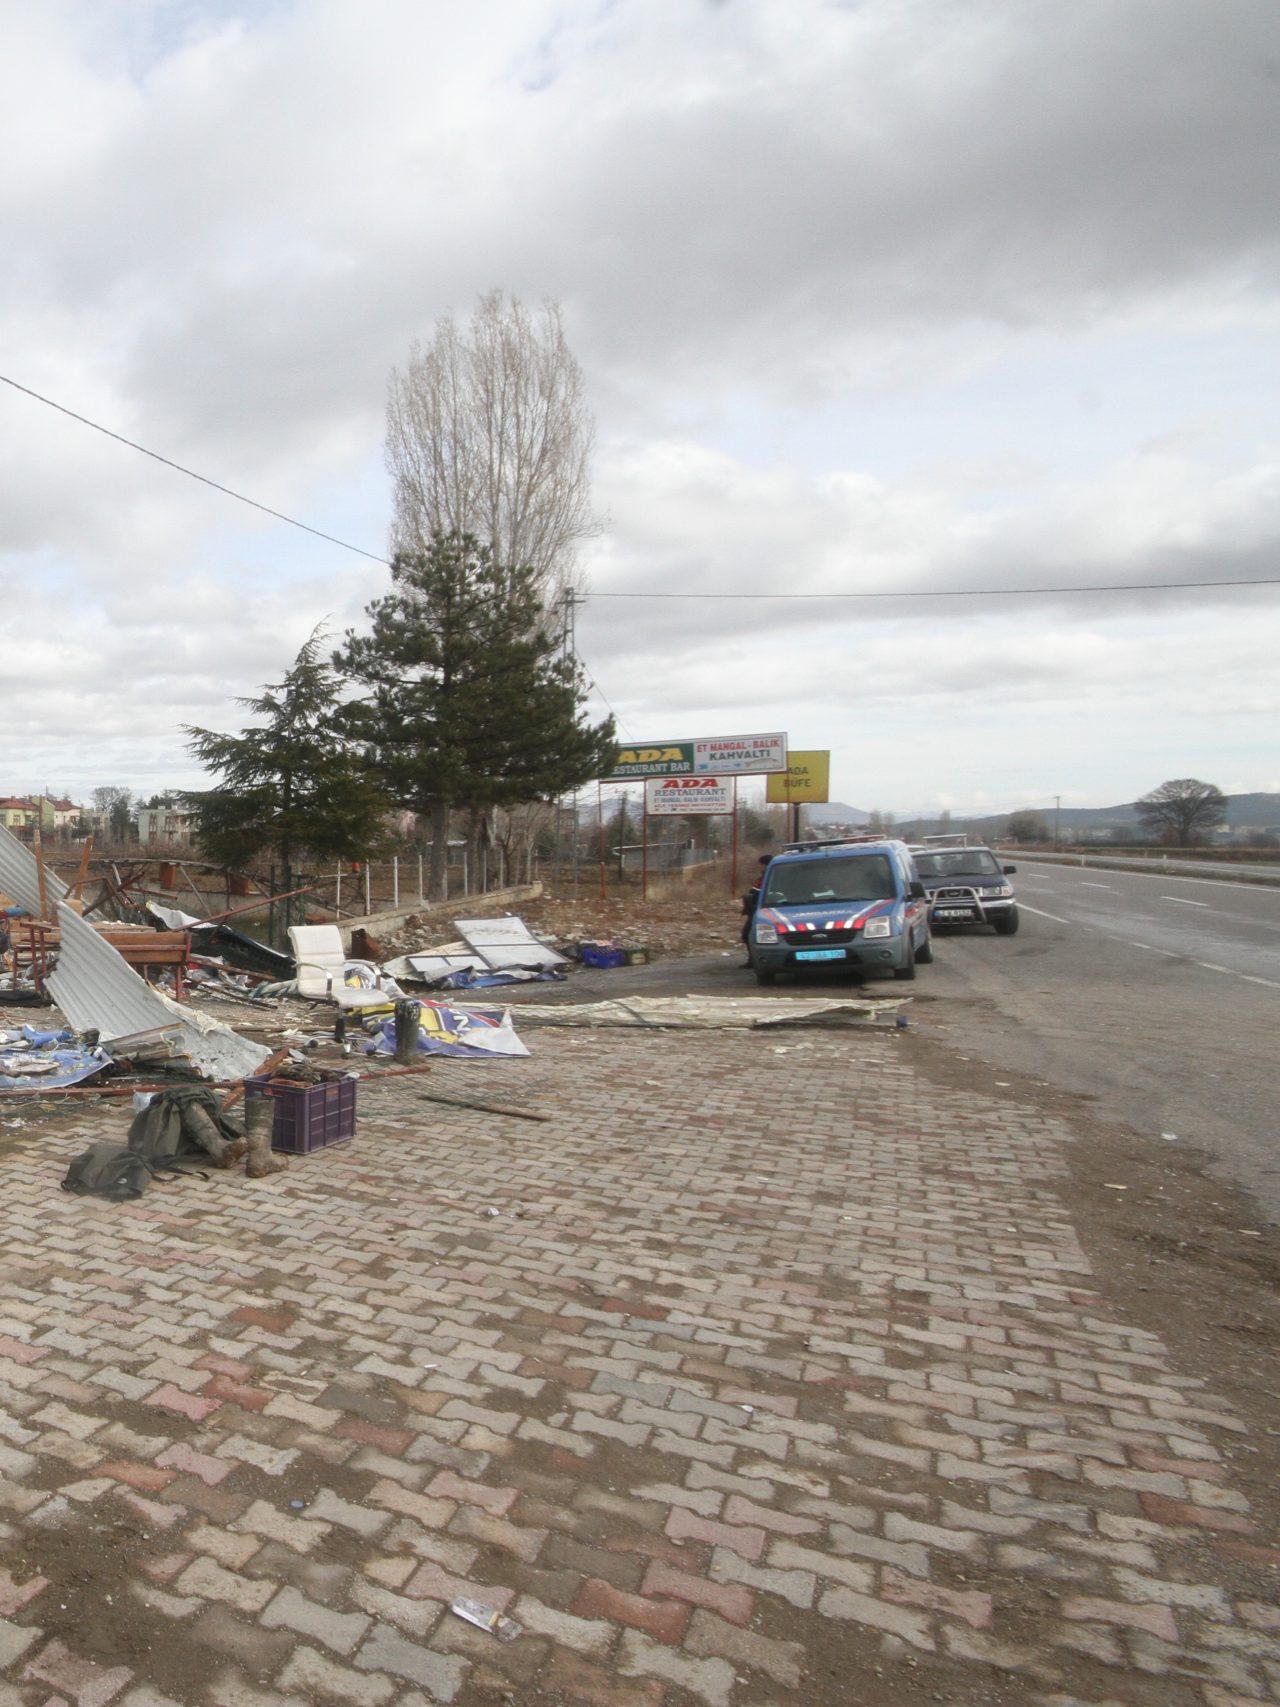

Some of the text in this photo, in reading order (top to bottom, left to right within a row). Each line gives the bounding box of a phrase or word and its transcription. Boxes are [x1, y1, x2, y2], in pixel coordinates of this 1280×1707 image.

[696, 743, 708, 752] ET
[618, 748, 683, 764] ADA
[709, 749, 771, 761] KAHVALTI
[613, 763, 668, 775] ESTAURANT
[670, 761, 691, 772] BAR
[661, 778, 719, 789] ADA
[654, 788, 727, 797] RESTAURANT
